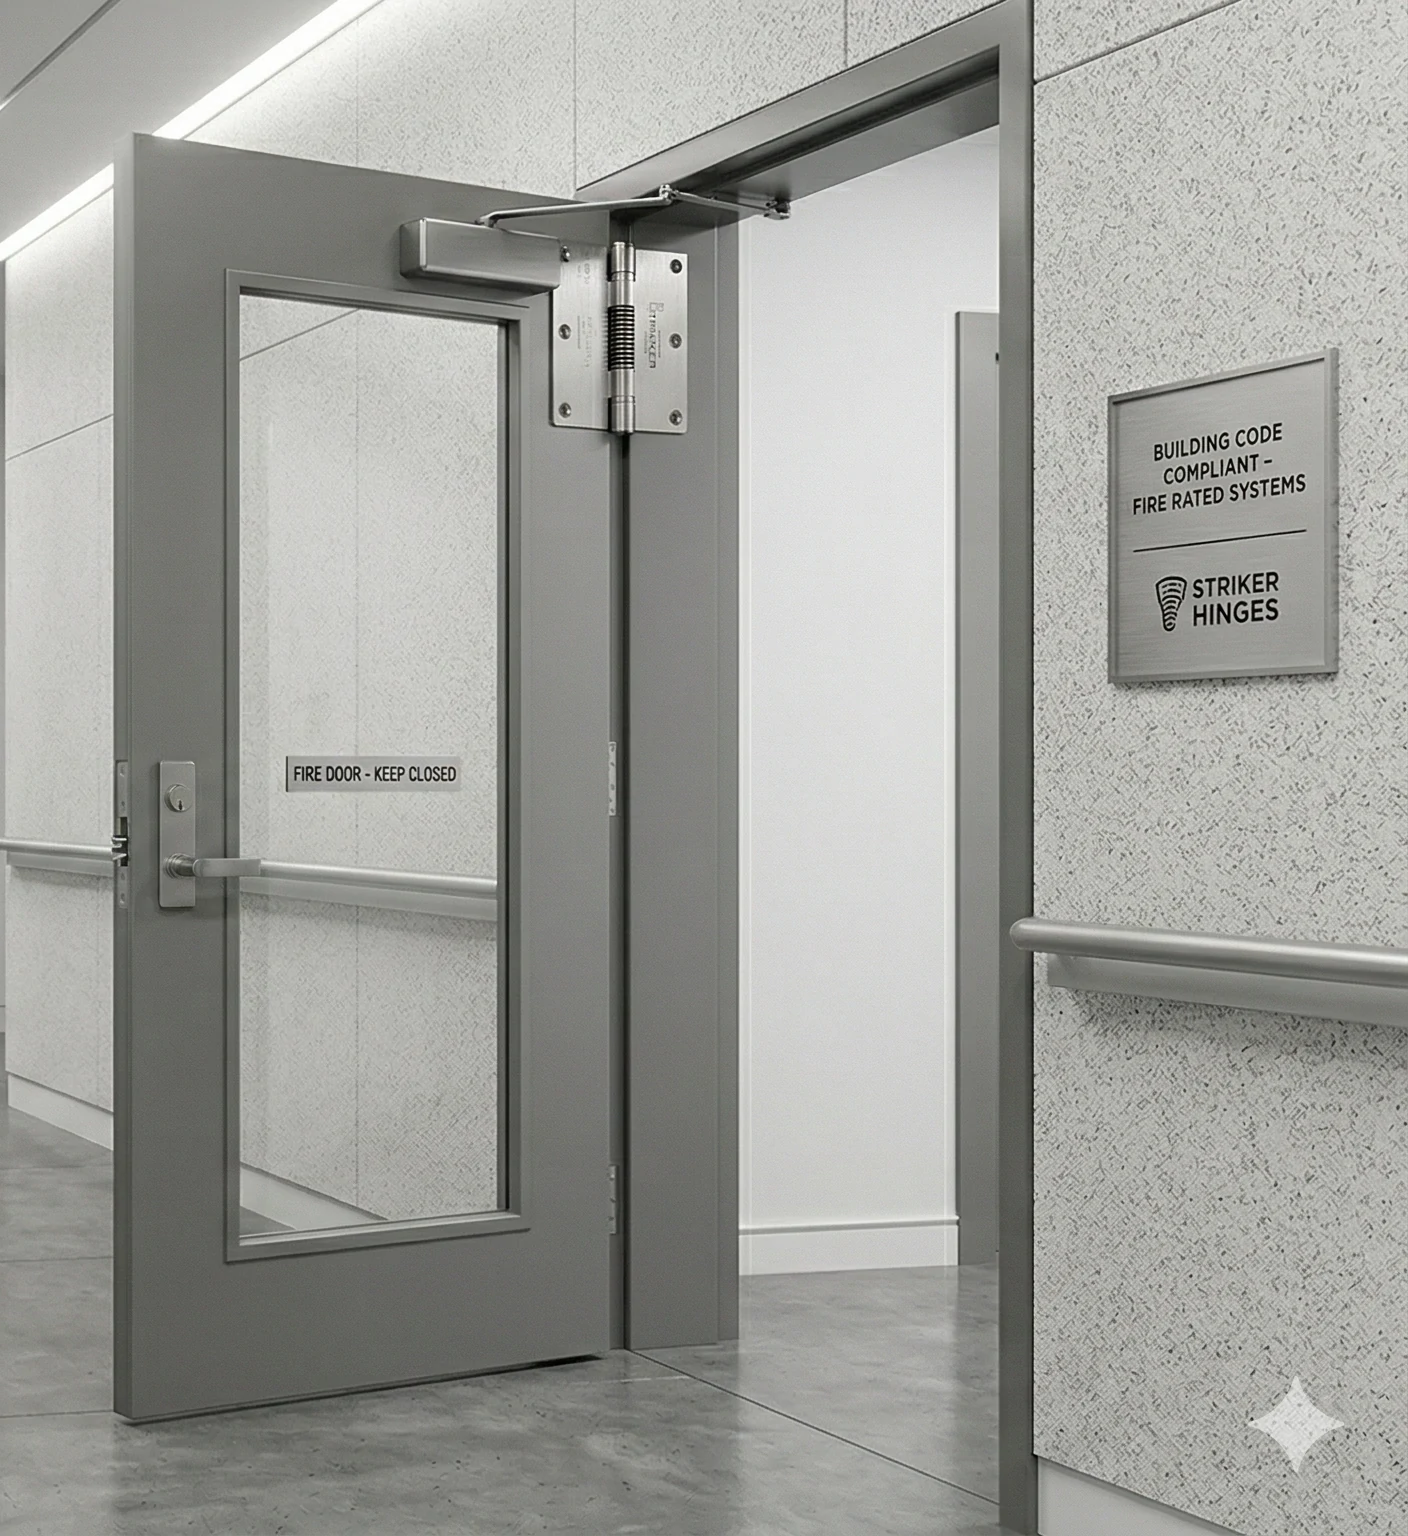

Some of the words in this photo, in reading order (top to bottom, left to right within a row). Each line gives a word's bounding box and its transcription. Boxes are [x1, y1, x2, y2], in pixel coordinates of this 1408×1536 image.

[1153, 431, 1230, 462] BUILDING
[1235, 422, 1283, 448] CODE
[1163, 453, 1260, 485] COMPLIANT
[1133, 493, 1167, 516] FIRE
[1171, 486, 1225, 511] RATED
[1229, 473, 1306, 502] SYSTEMS
[1192, 571, 1279, 599] STRIKER
[1193, 597, 1279, 627] HINGES
[293, 765, 322, 782] FIRE
[325, 765, 362, 782] DOOR
[374, 766, 406, 782] KEEP
[408, 765, 457, 782] CLOSED
